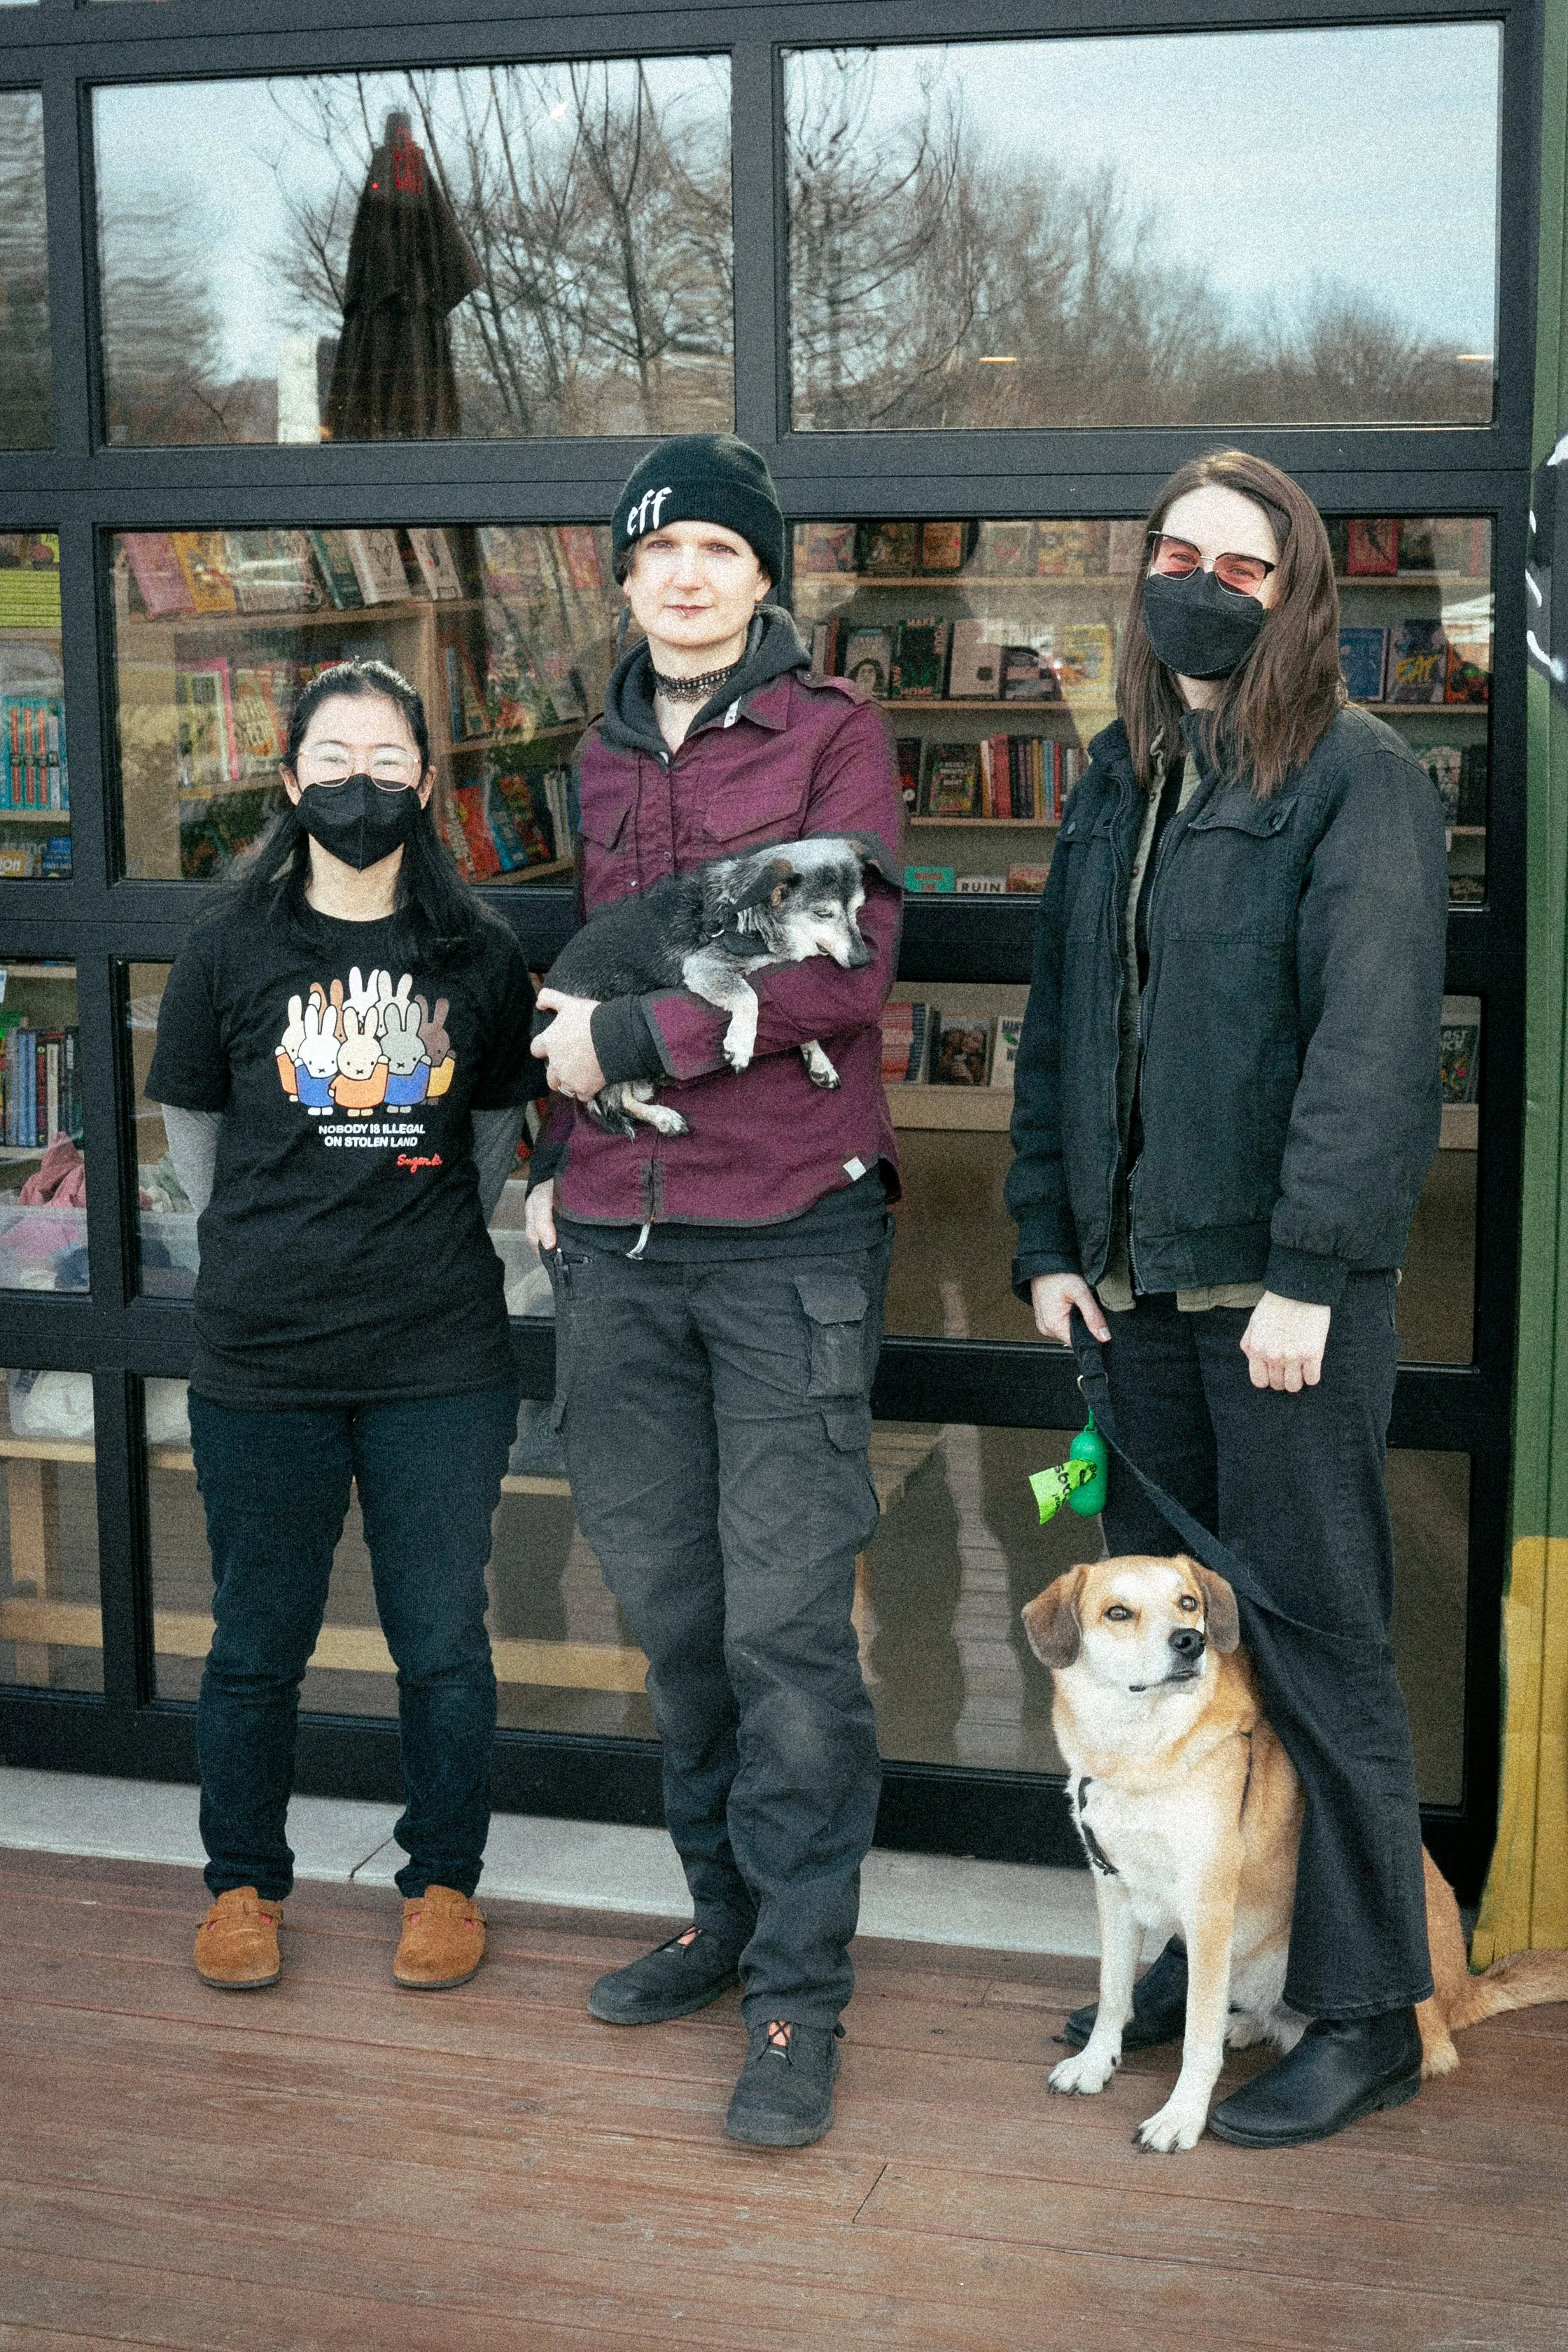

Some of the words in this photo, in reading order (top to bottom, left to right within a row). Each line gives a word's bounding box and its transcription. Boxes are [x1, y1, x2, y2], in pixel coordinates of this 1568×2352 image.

[627, 487, 672, 536] eff
[901, 687, 933, 696] HOME
[961, 882, 1001, 892] RUIN
[318, 1124, 368, 1134] NOBODY
[370, 1124, 380, 1134] IS
[382, 1124, 425, 1134] ILLEGAL
[324, 1136, 342, 1147] ON
[344, 1136, 388, 1147] STOLEN
[391, 1136, 418, 1147] LAND
